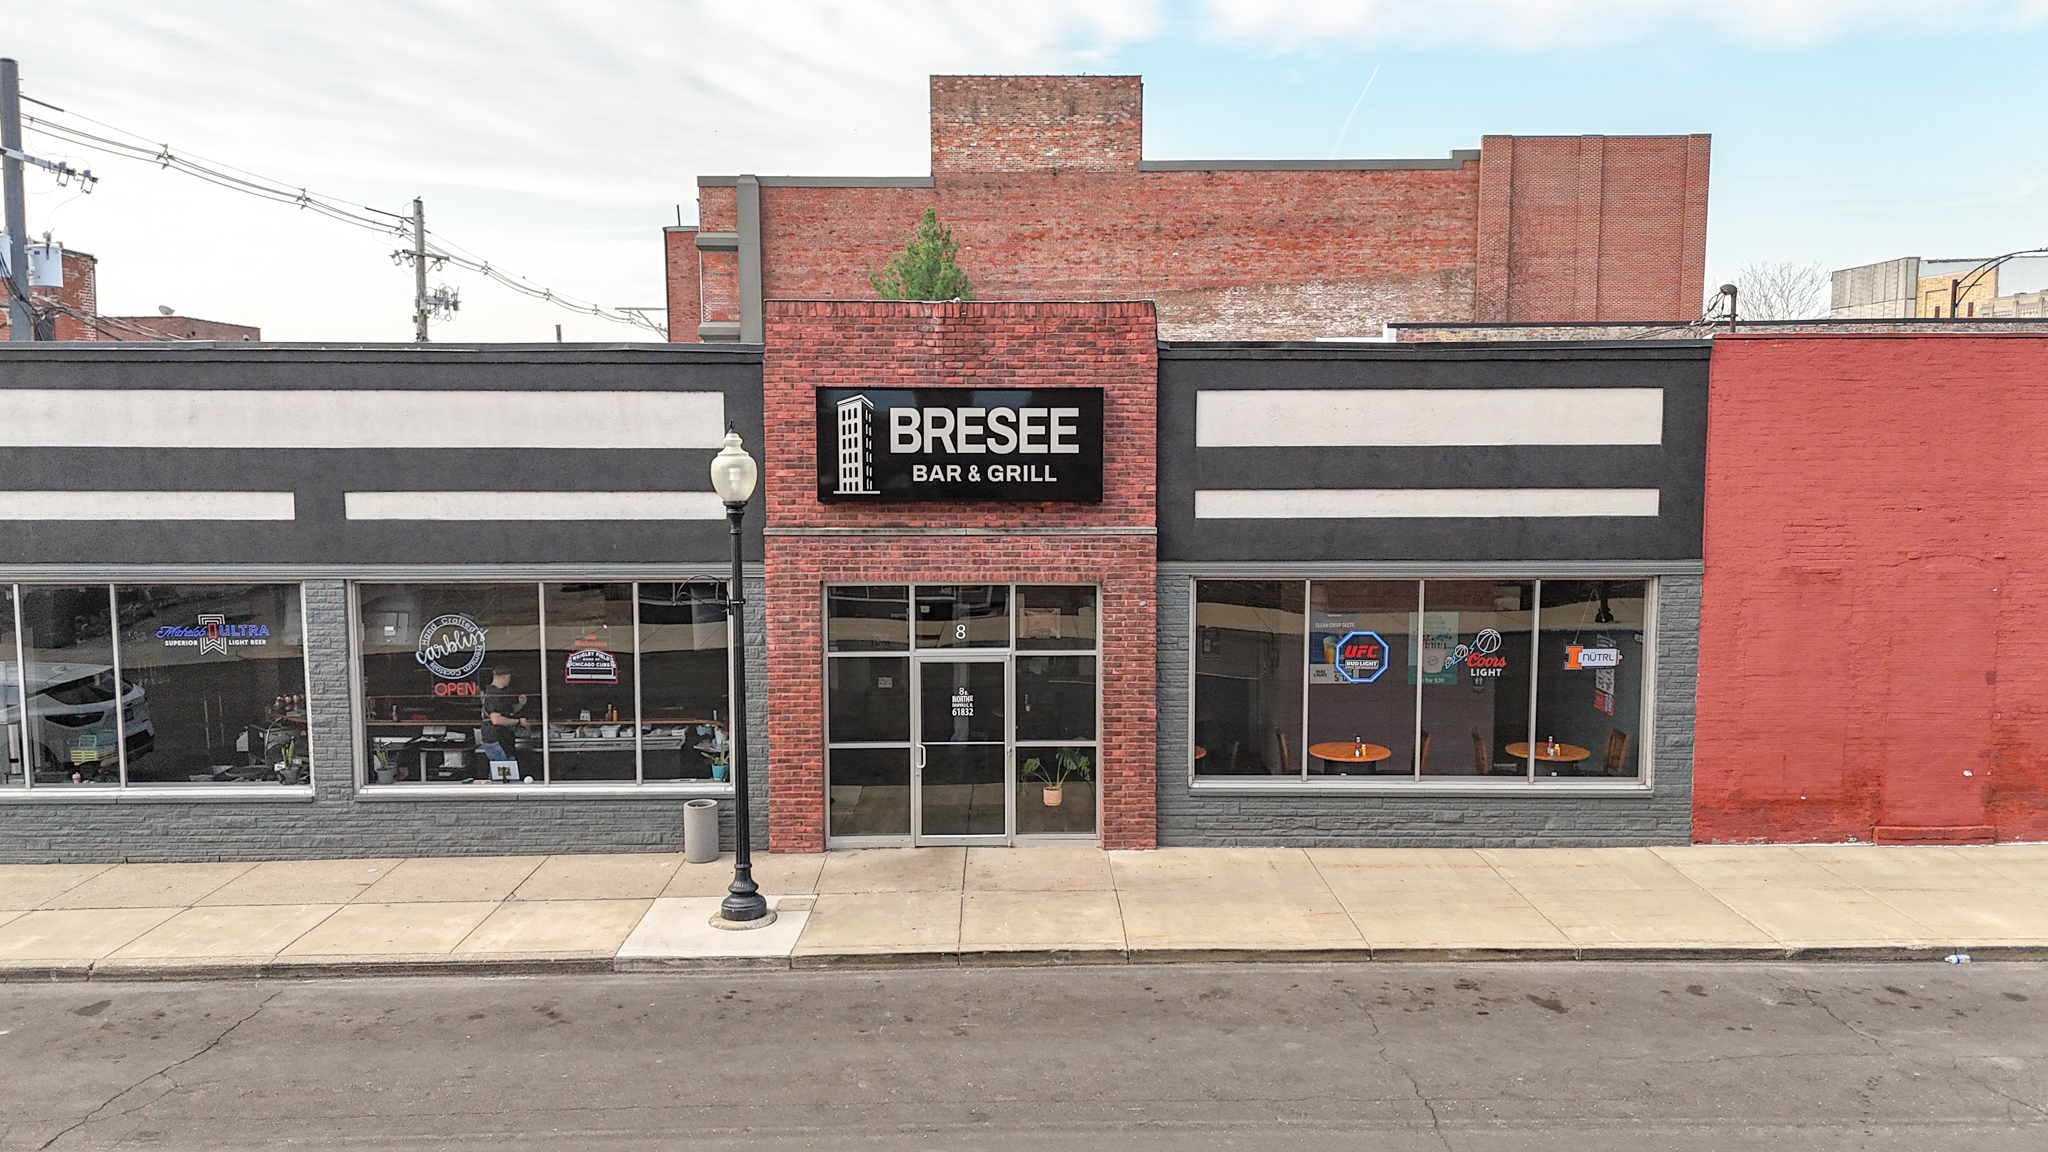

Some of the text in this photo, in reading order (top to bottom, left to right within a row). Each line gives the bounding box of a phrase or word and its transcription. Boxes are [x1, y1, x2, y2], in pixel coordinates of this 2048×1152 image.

[890, 407, 1080, 454] BRESEE
[912, 464, 1057, 482] BAR & GRILL
[156, 624, 270, 638] Michelob ULTRA
[421, 617, 476, 646] Hand Crafted
[956, 624, 966, 639] 8
[572, 651, 610, 662] WRIGLEY FIELD
[1344, 645, 1379, 658] UFC
[429, 645, 483, 676] Premium Cocktails
[1467, 652, 1507, 668] Coors
[1471, 668, 1502, 677] LIGHT
[435, 682, 477, 697] OPEN
[959, 687, 965, 695] 8
[952, 695, 969, 703] NORTH
[952, 708, 974, 716] 61832
